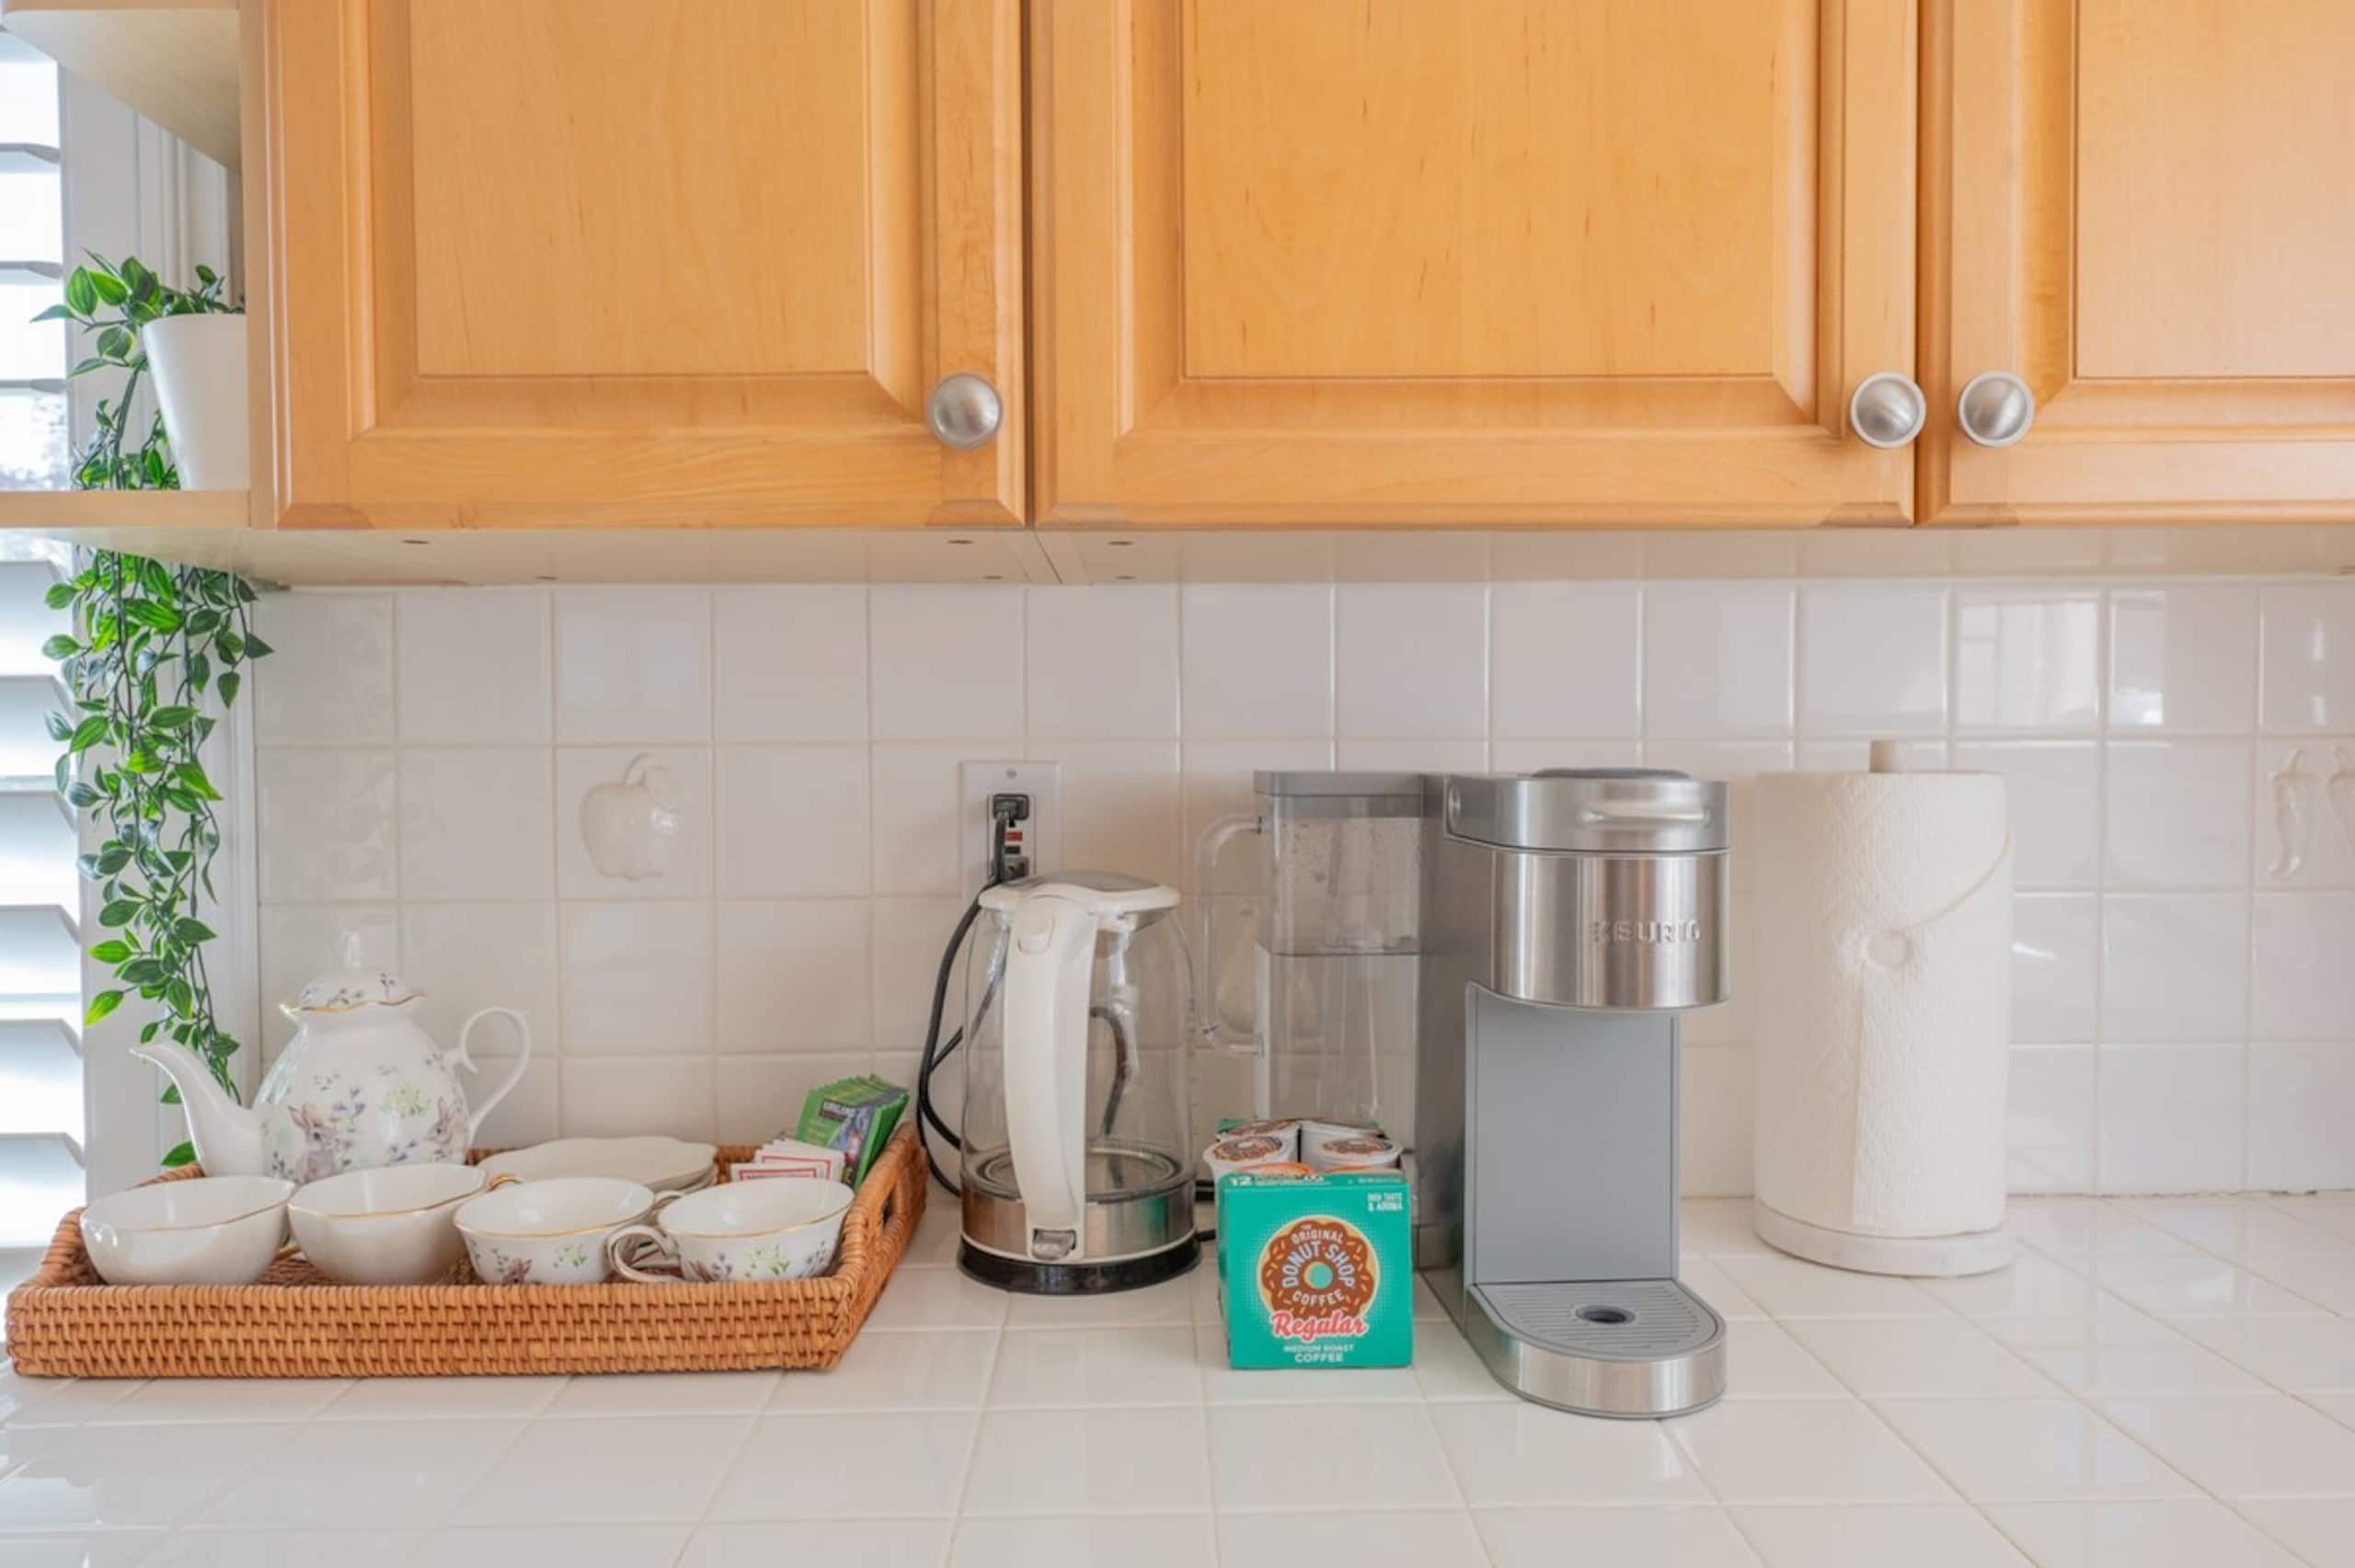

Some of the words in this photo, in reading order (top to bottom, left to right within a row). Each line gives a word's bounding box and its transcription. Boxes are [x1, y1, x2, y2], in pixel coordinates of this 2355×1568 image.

[1291, 1229, 1344, 1245] ORIGINAL
[1282, 1241, 1322, 1288] DONUT
[1325, 1243, 1355, 1288] SHOP
[1292, 1288, 1346, 1307] COFFEE
[1270, 1309, 1369, 1343] Regular
[1294, 1353, 1344, 1363] COFFEE
